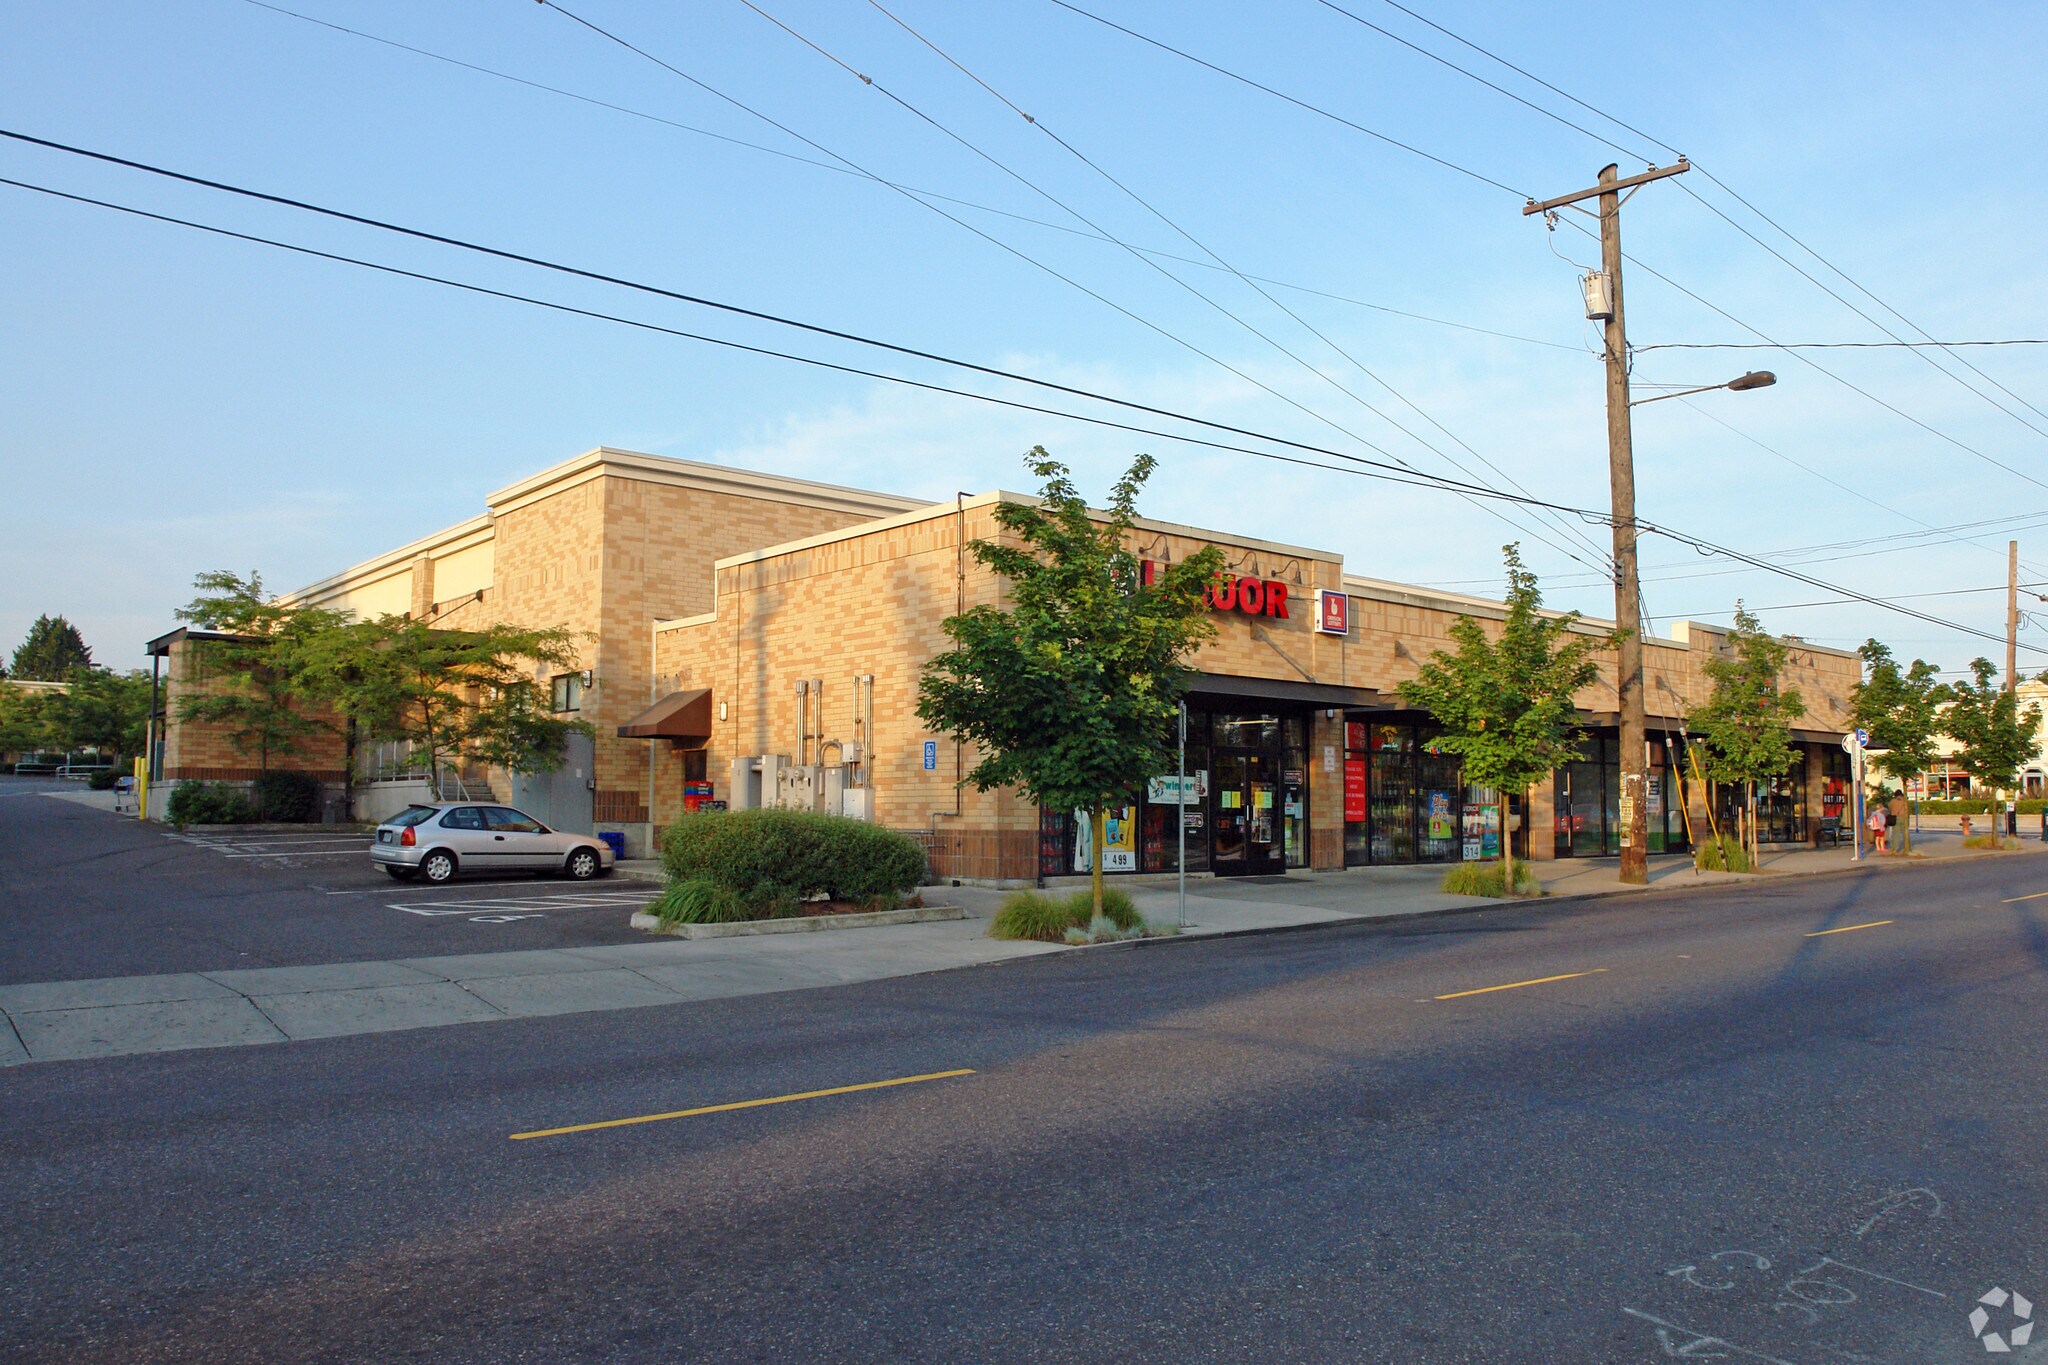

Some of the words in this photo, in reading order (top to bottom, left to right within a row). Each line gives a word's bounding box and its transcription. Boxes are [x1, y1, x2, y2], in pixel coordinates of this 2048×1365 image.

[1165, 781, 1193, 792] winer
[1824, 795, 1834, 803] HOT
[1464, 846, 1479, 857] 314
